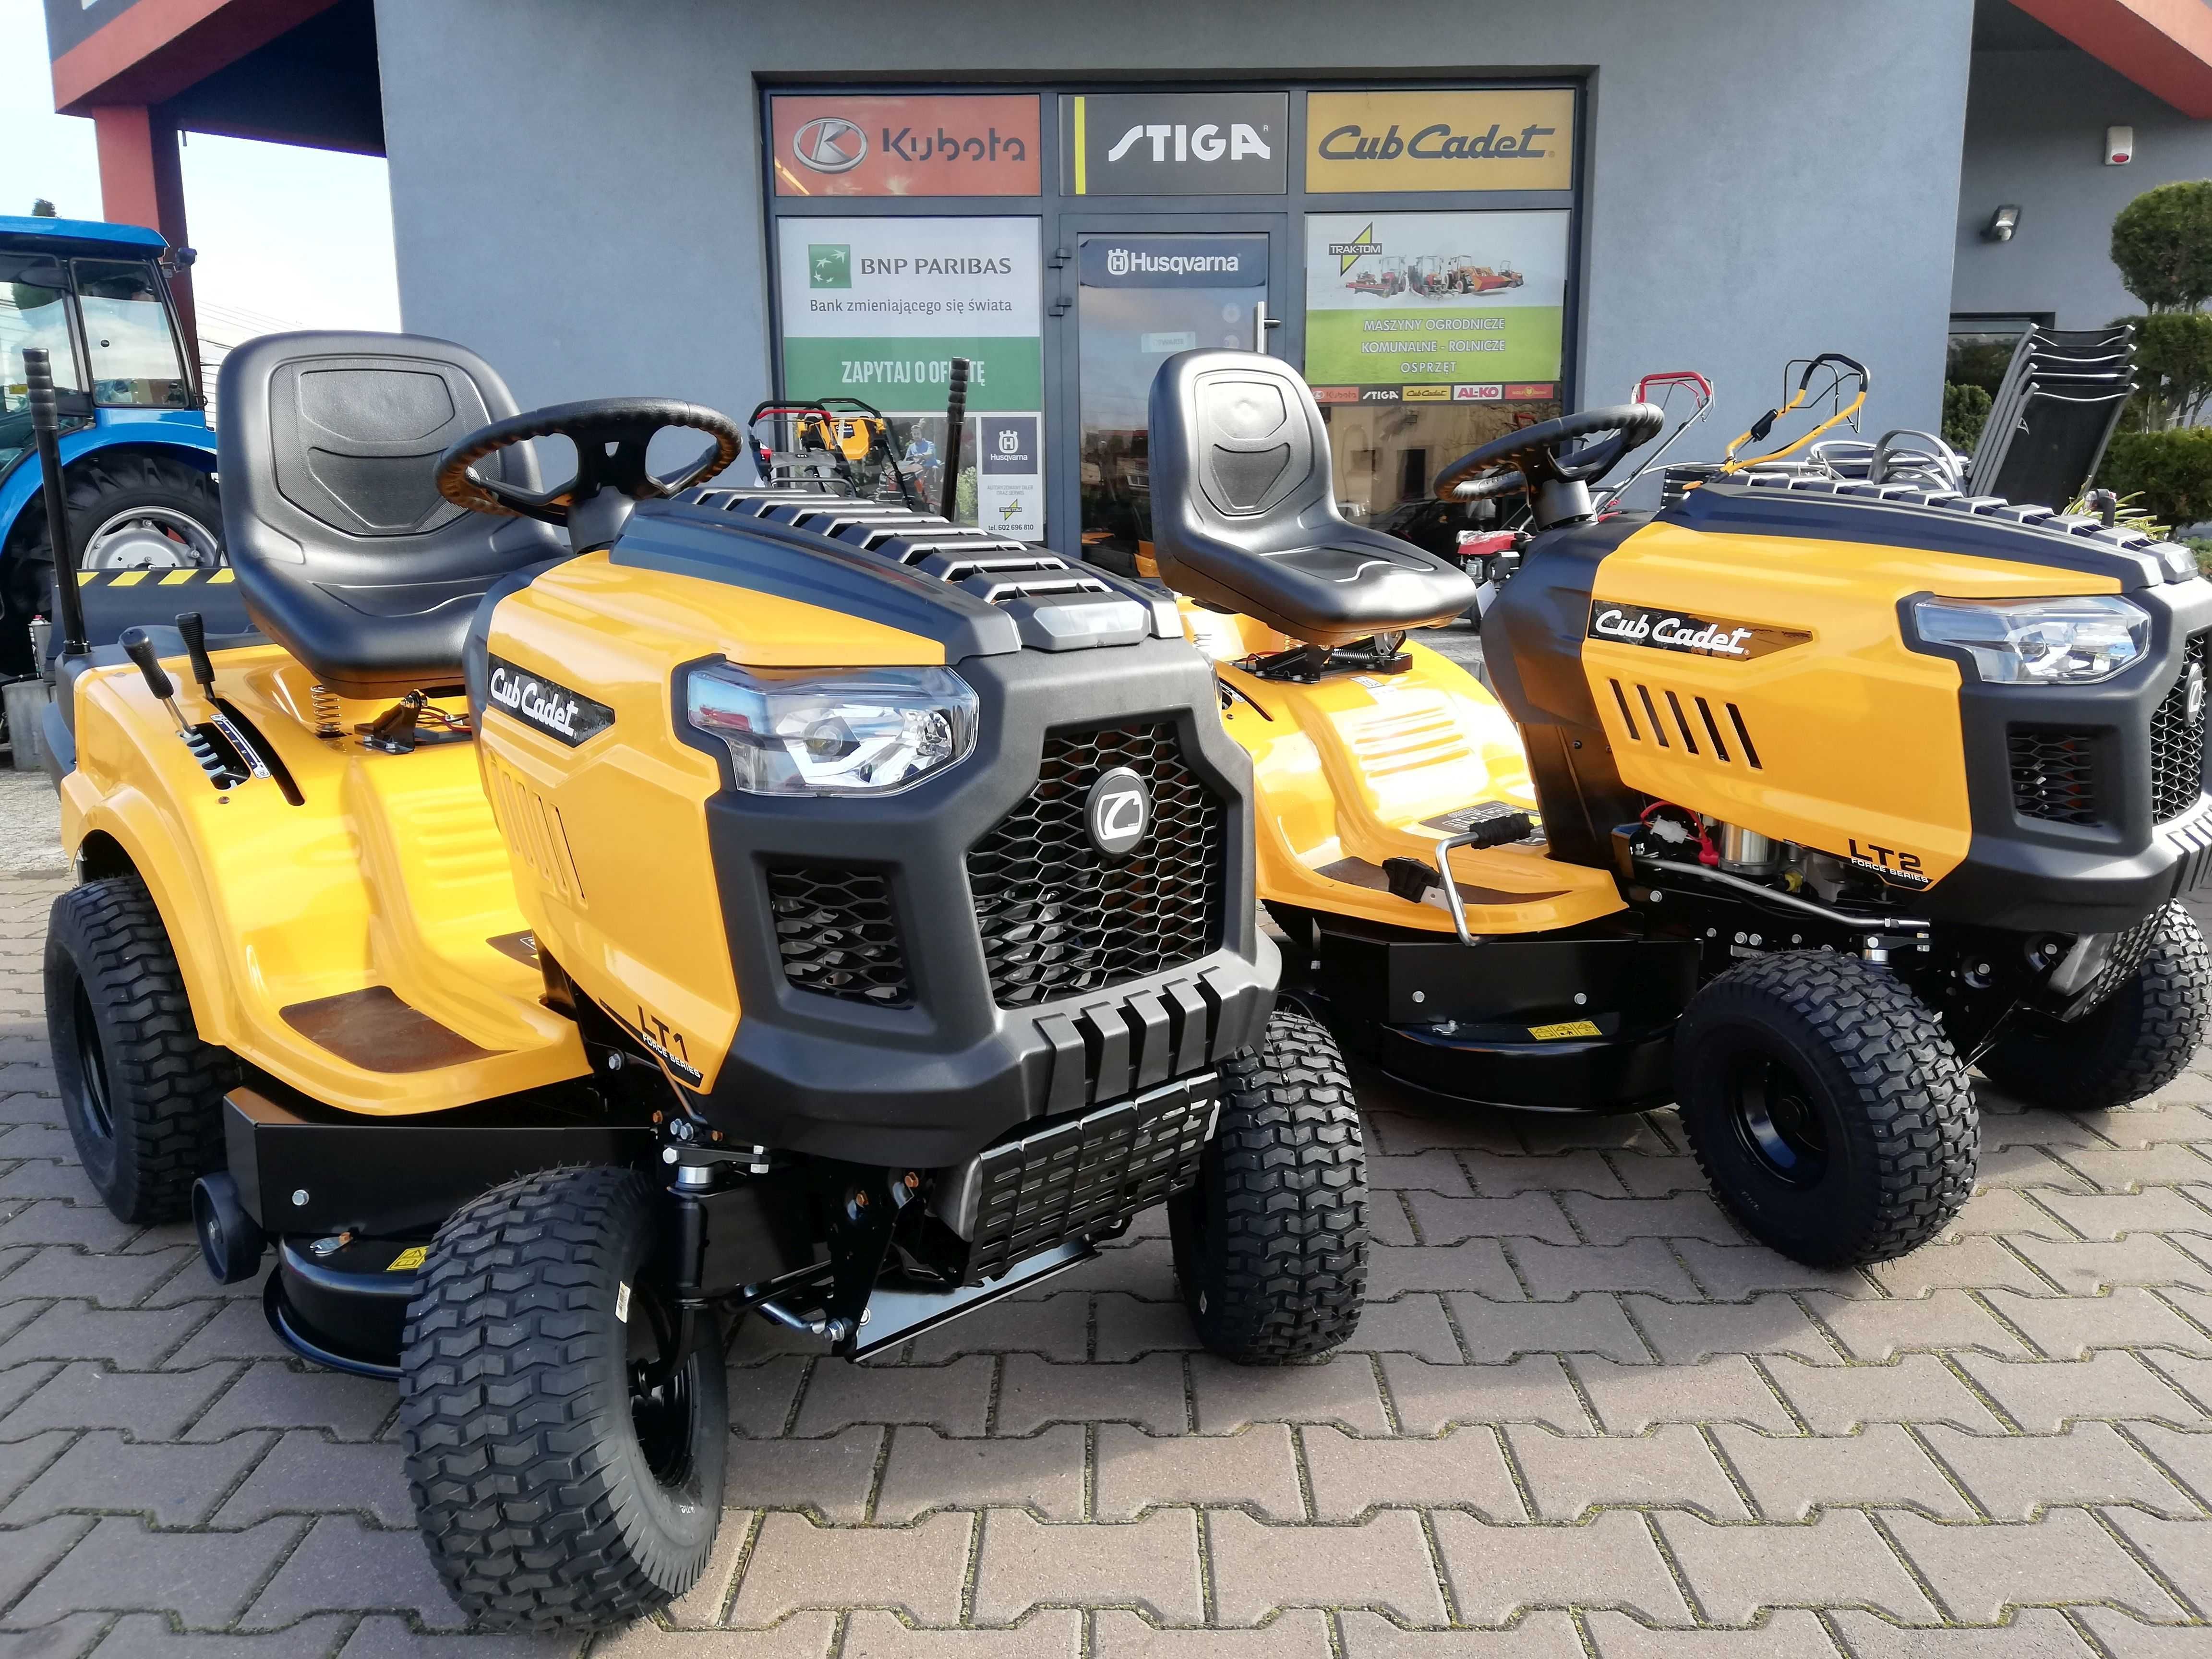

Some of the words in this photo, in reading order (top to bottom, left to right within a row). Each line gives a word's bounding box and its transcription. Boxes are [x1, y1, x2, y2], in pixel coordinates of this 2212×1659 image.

[882, 127, 1025, 162] Kubota
[1108, 124, 1271, 162] STIGA
[1318, 124, 1404, 160] Cub
[1407, 123, 1556, 159] Cadet
[1330, 244, 1381, 254] TRAK-TOM
[860, 257, 908, 275] BNP
[914, 257, 1012, 275] PARIBAS
[1131, 252, 1239, 275] Husqvarna
[810, 299, 843, 312] Bank
[847, 299, 941, 315] zmieniającego
[946, 299, 964, 314] się
[968, 298, 1012, 312] świata
[1363, 319, 1422, 331] MASZYNY
[1425, 318, 1505, 330] OGRODNICZE
[1361, 340, 1437, 353] KOMUNALNE
[1448, 339, 1506, 352] ROLNICZE
[841, 361, 911, 383] ZAPYTAJ
[914, 361, 925, 383] O
[929, 361, 986, 386] OFTĘ
[1400, 361, 1456, 375] OSPRZĘT
[1362, 391, 1398, 399] STIGA
[1457, 387, 1499, 398] AL-KO
[1595, 609, 1650, 639] Cub
[1652, 617, 1753, 655] Cadet
[490, 667, 520, 709] Cub
[521, 682, 579, 737] Cadet
[1848, 838, 1924, 875] LT2
[1851, 857, 1887, 873] FORCE
[1889, 868, 1929, 883] SERIES
[637, 1004, 689, 1063] LT1
[641, 1033, 669, 1058] FORCE
[669, 1052, 701, 1079] SERIES
